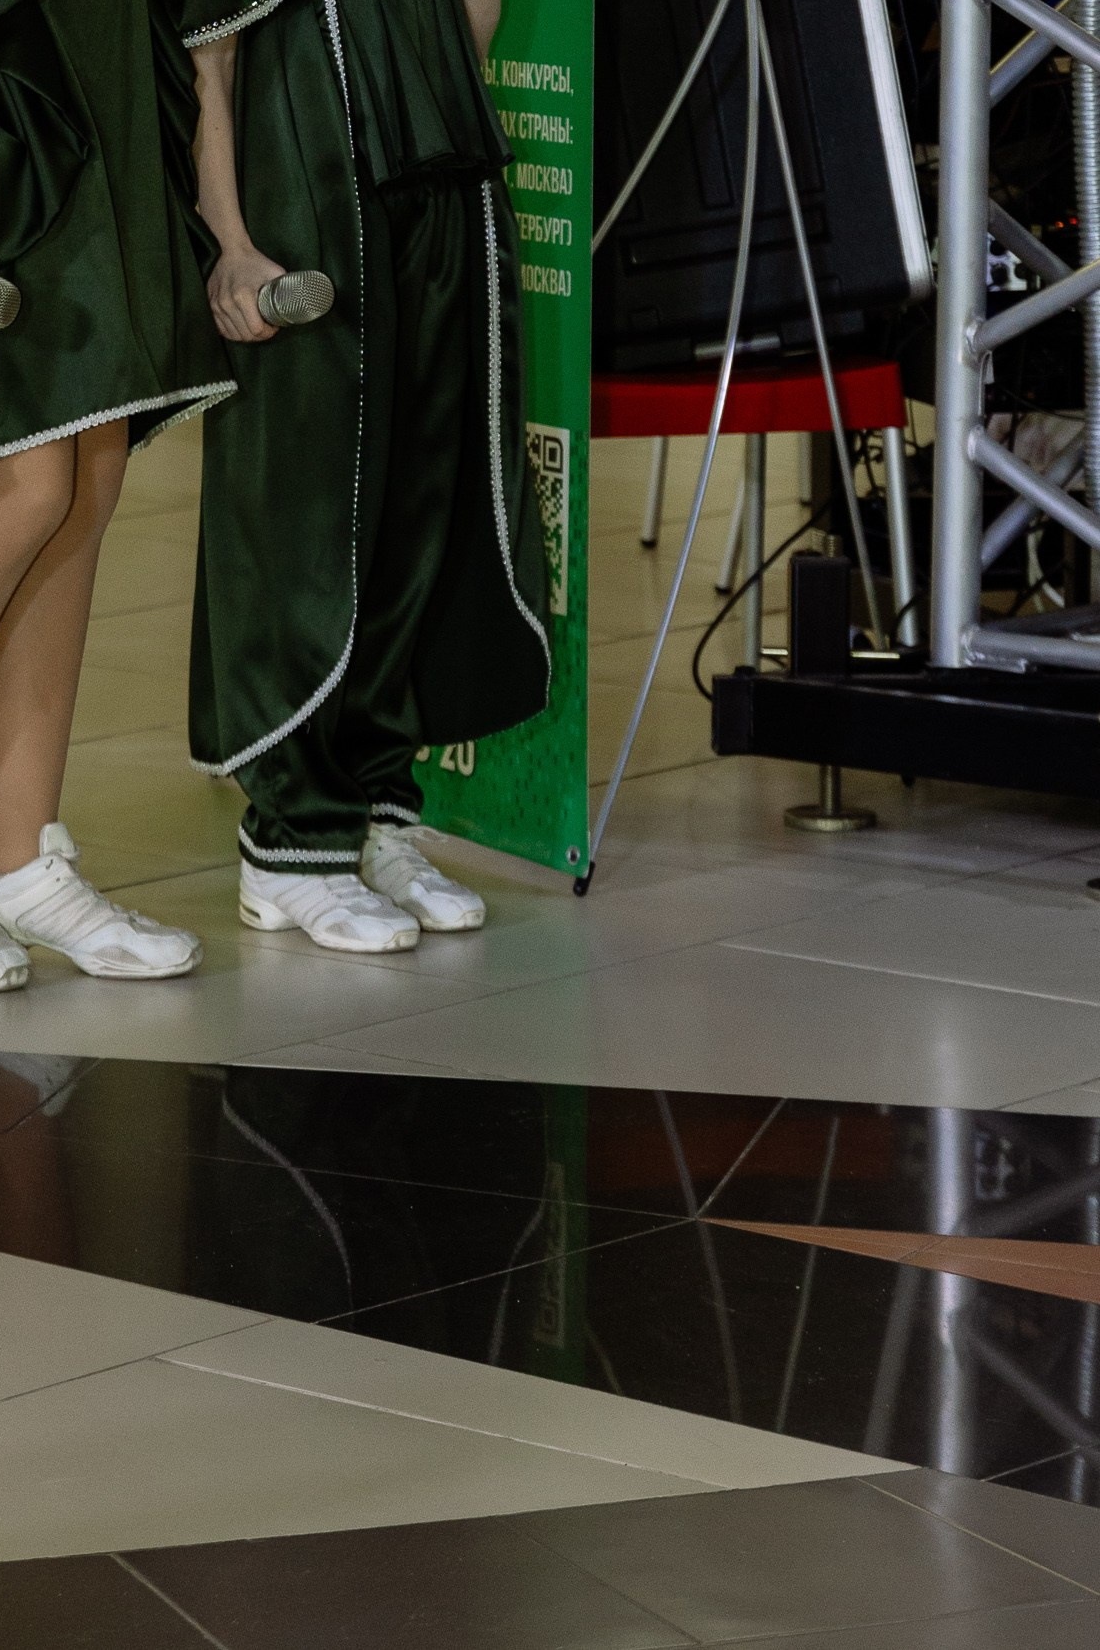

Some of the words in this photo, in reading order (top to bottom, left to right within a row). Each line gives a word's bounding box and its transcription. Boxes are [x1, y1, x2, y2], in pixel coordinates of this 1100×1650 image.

[502, 60, 574, 97] КОНКУРСЫ,
[497, 110, 517, 138] АХ
[519, 112, 574, 145] СТРАНЫ:
[516, 162, 573, 196] МОСКВА)
